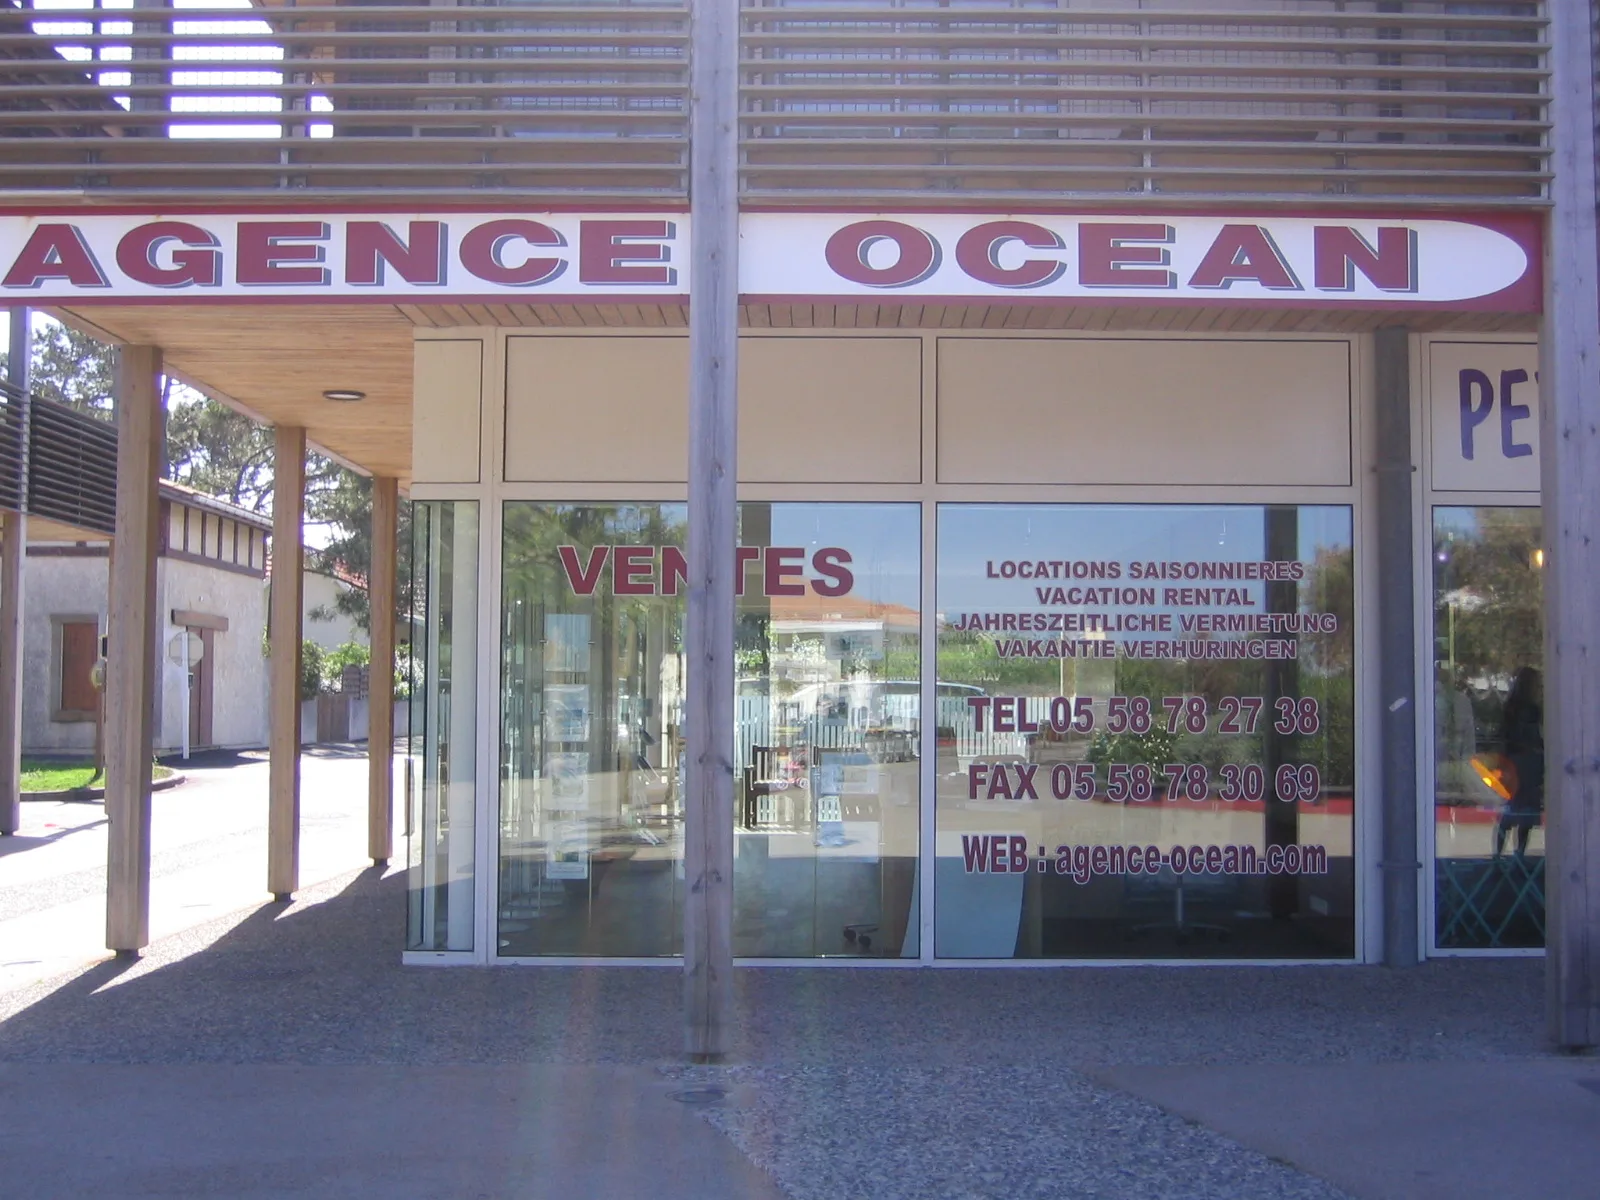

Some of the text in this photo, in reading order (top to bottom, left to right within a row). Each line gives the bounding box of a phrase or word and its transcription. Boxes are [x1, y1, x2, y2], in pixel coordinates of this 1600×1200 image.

[1, 219, 1420, 293] AGENCE OCEAN
[1459, 368, 1539, 461] PE
[986, 560, 1304, 581] LOCATIONS SAISONNIERES
[1036, 587, 1255, 606] VACATION RENTAL
[954, 613, 1338, 634] JAHRESZEITLICHE VERMIETUNG
[995, 639, 1297, 660] VAKANTIE VERHURINGEN
[967, 696, 1320, 735] TEL 05 58 78 27 38
[968, 763, 1320, 802] FAX 05 58 78 30 69
[962, 834, 1029, 873] WEB
[1054, 842, 1328, 884] agence-ocean.com
